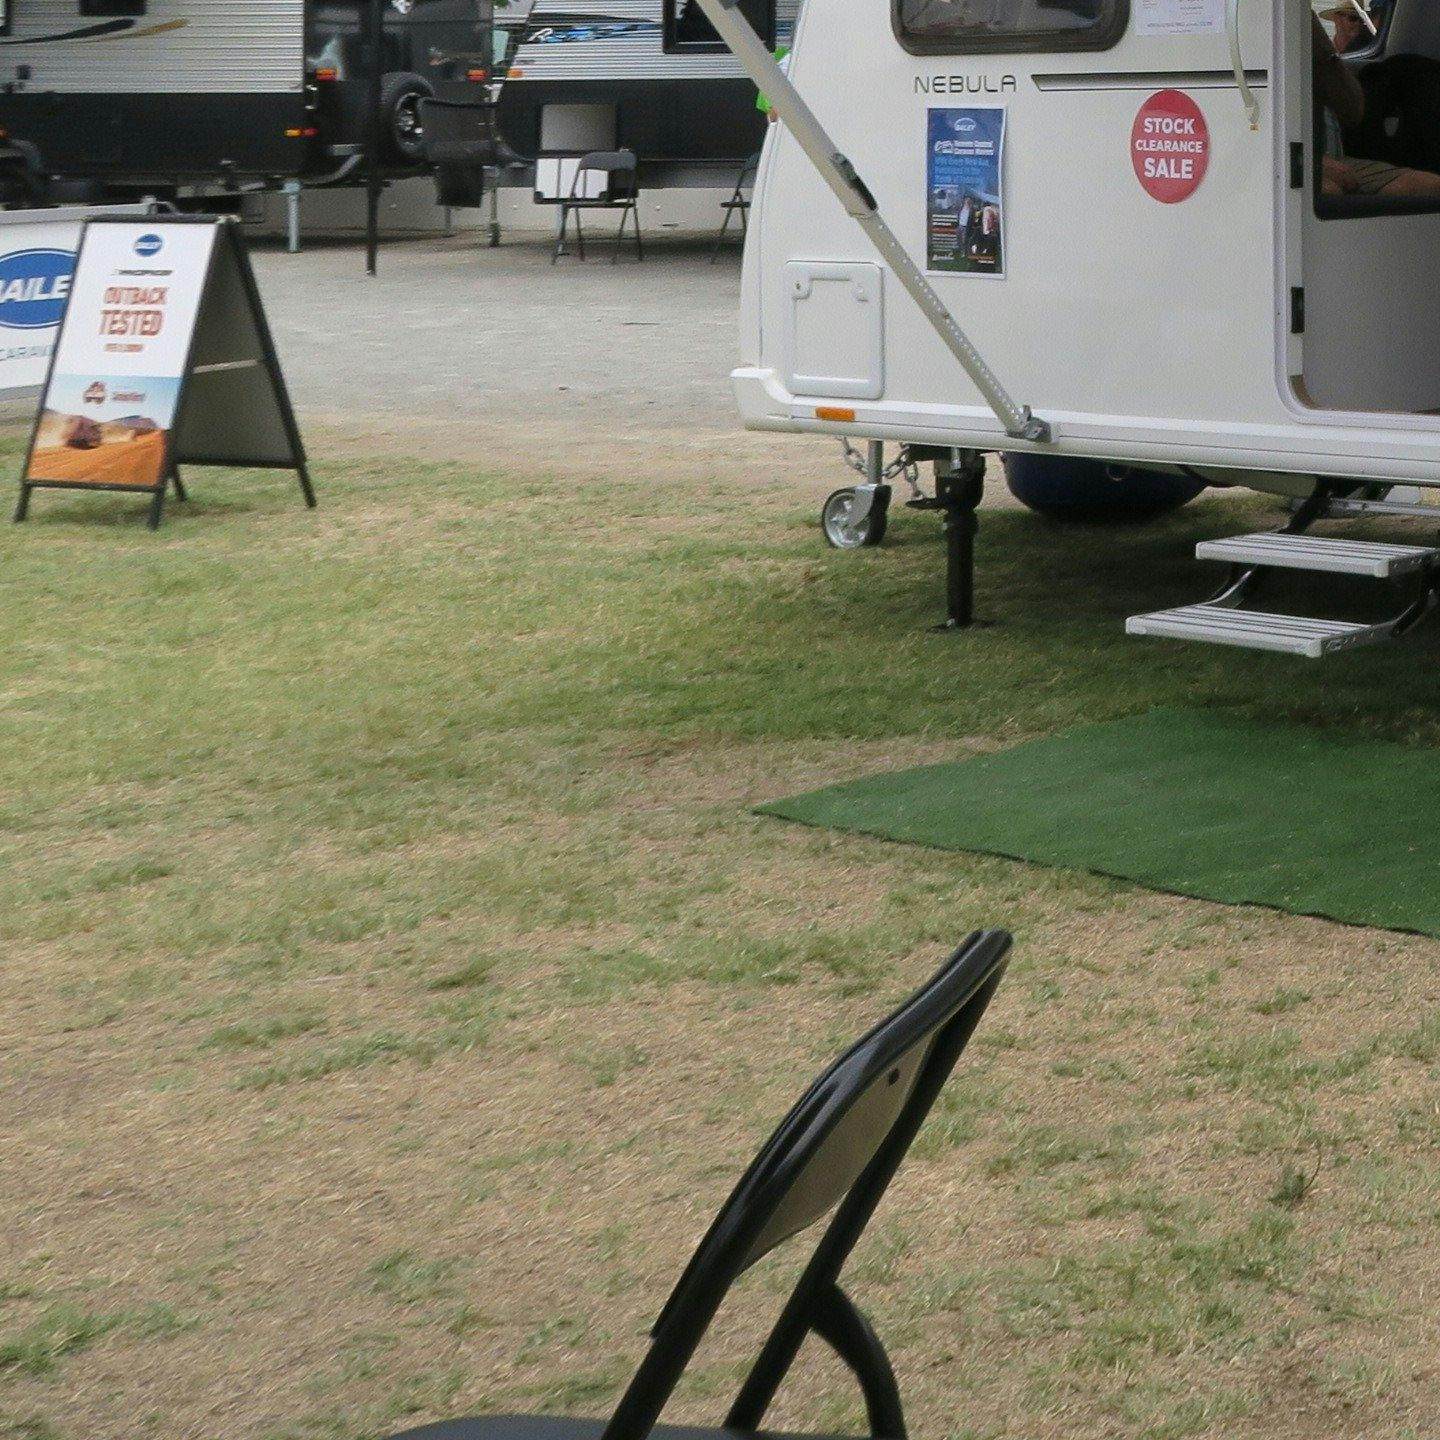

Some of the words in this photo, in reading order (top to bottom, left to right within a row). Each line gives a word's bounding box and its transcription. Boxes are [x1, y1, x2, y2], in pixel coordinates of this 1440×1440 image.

[915, 74, 1017, 94] NEBULA
[1143, 117, 1196, 135] STOCK
[1135, 139, 1204, 154] CLEARANCE
[1143, 157, 1194, 179] SALE
[0, 274, 71, 304] AILE
[103, 286, 169, 305] OUTBACK
[99, 310, 163, 336] TESTED
